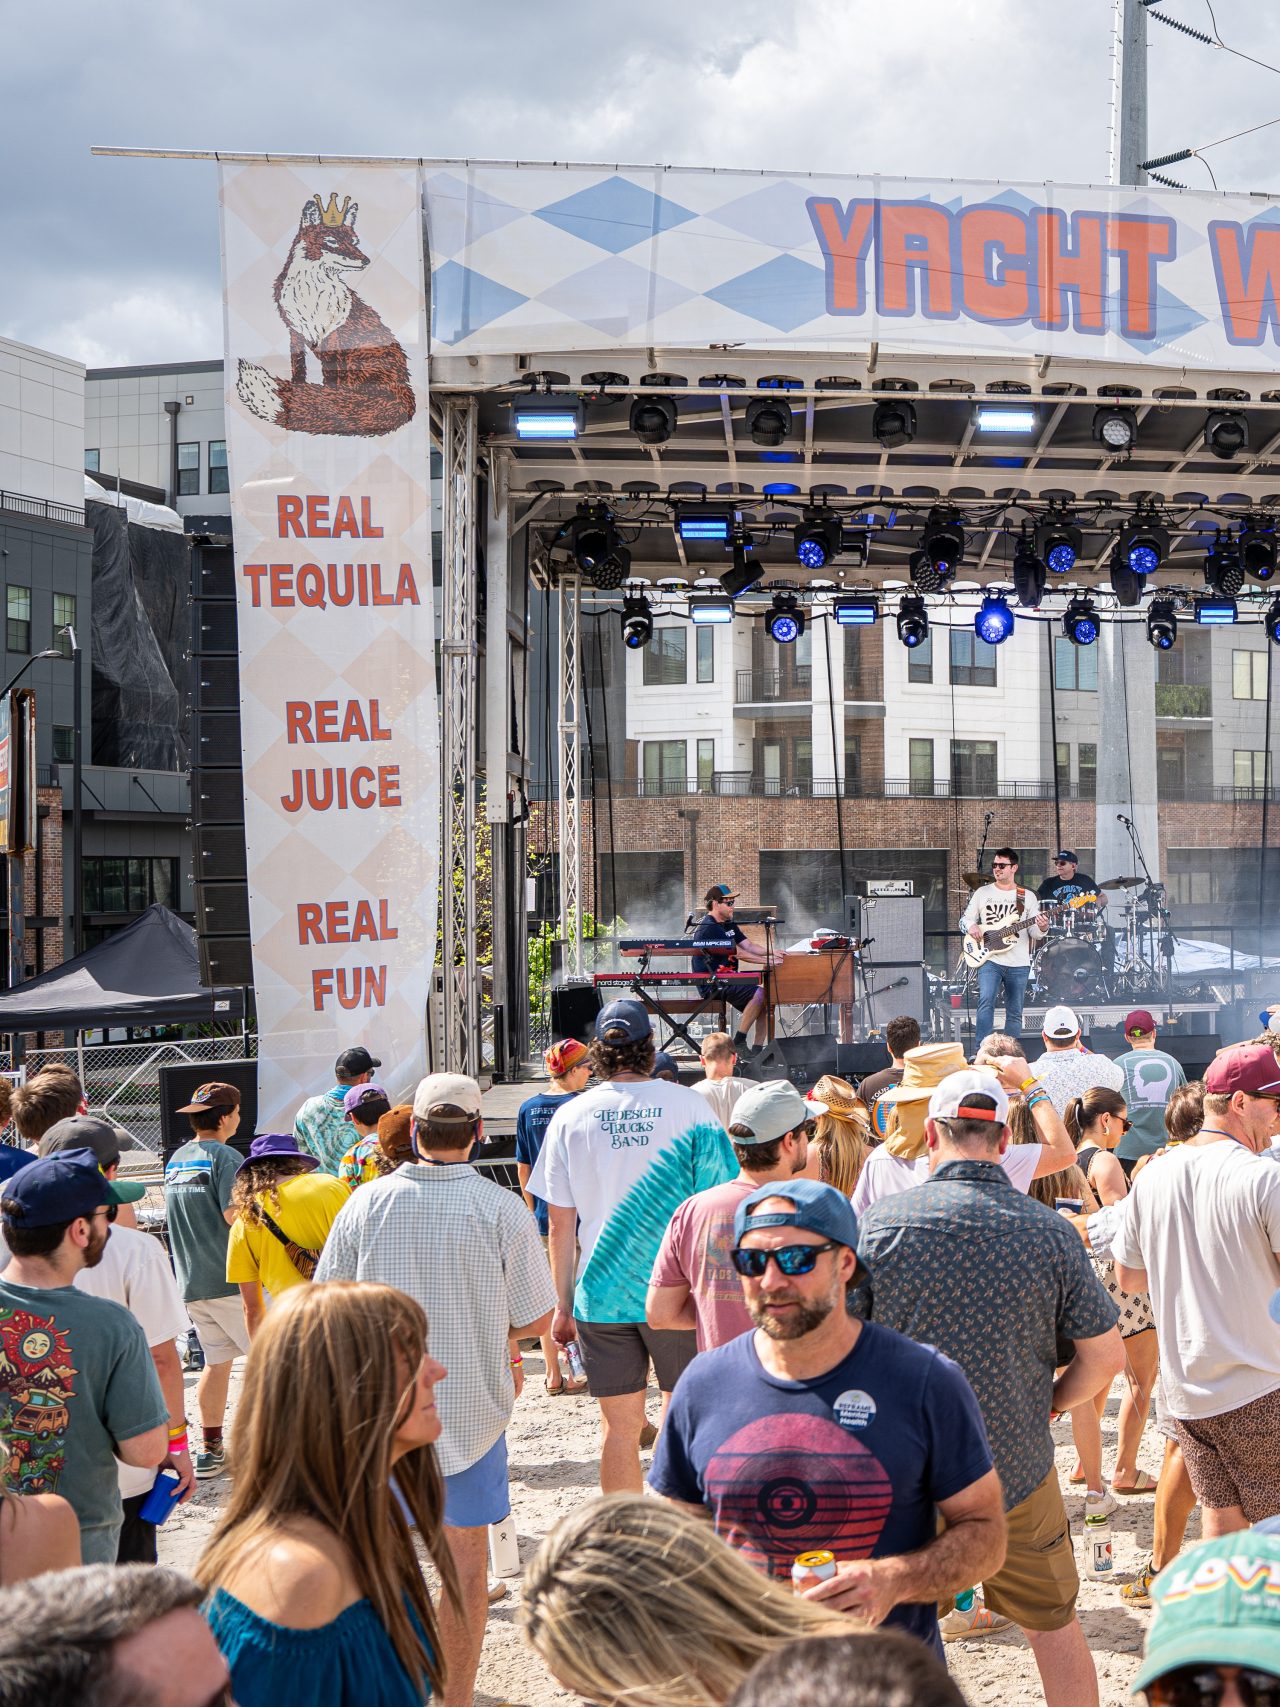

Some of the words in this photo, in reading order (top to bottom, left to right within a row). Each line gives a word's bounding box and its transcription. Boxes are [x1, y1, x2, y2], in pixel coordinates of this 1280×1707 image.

[806, 196, 1177, 341] YACHT
[277, 495, 384, 539] REAL
[243, 563, 420, 611] TEQUILA
[286, 699, 392, 744] REAL
[280, 765, 402, 812] JUICE
[297, 899, 398, 945] REAL
[312, 965, 387, 1011] FUN
[594, 1107, 663, 1123] TEDESCHI
[601, 1121, 654, 1135] TRUCKS
[612, 1135, 649, 1150] BAND
